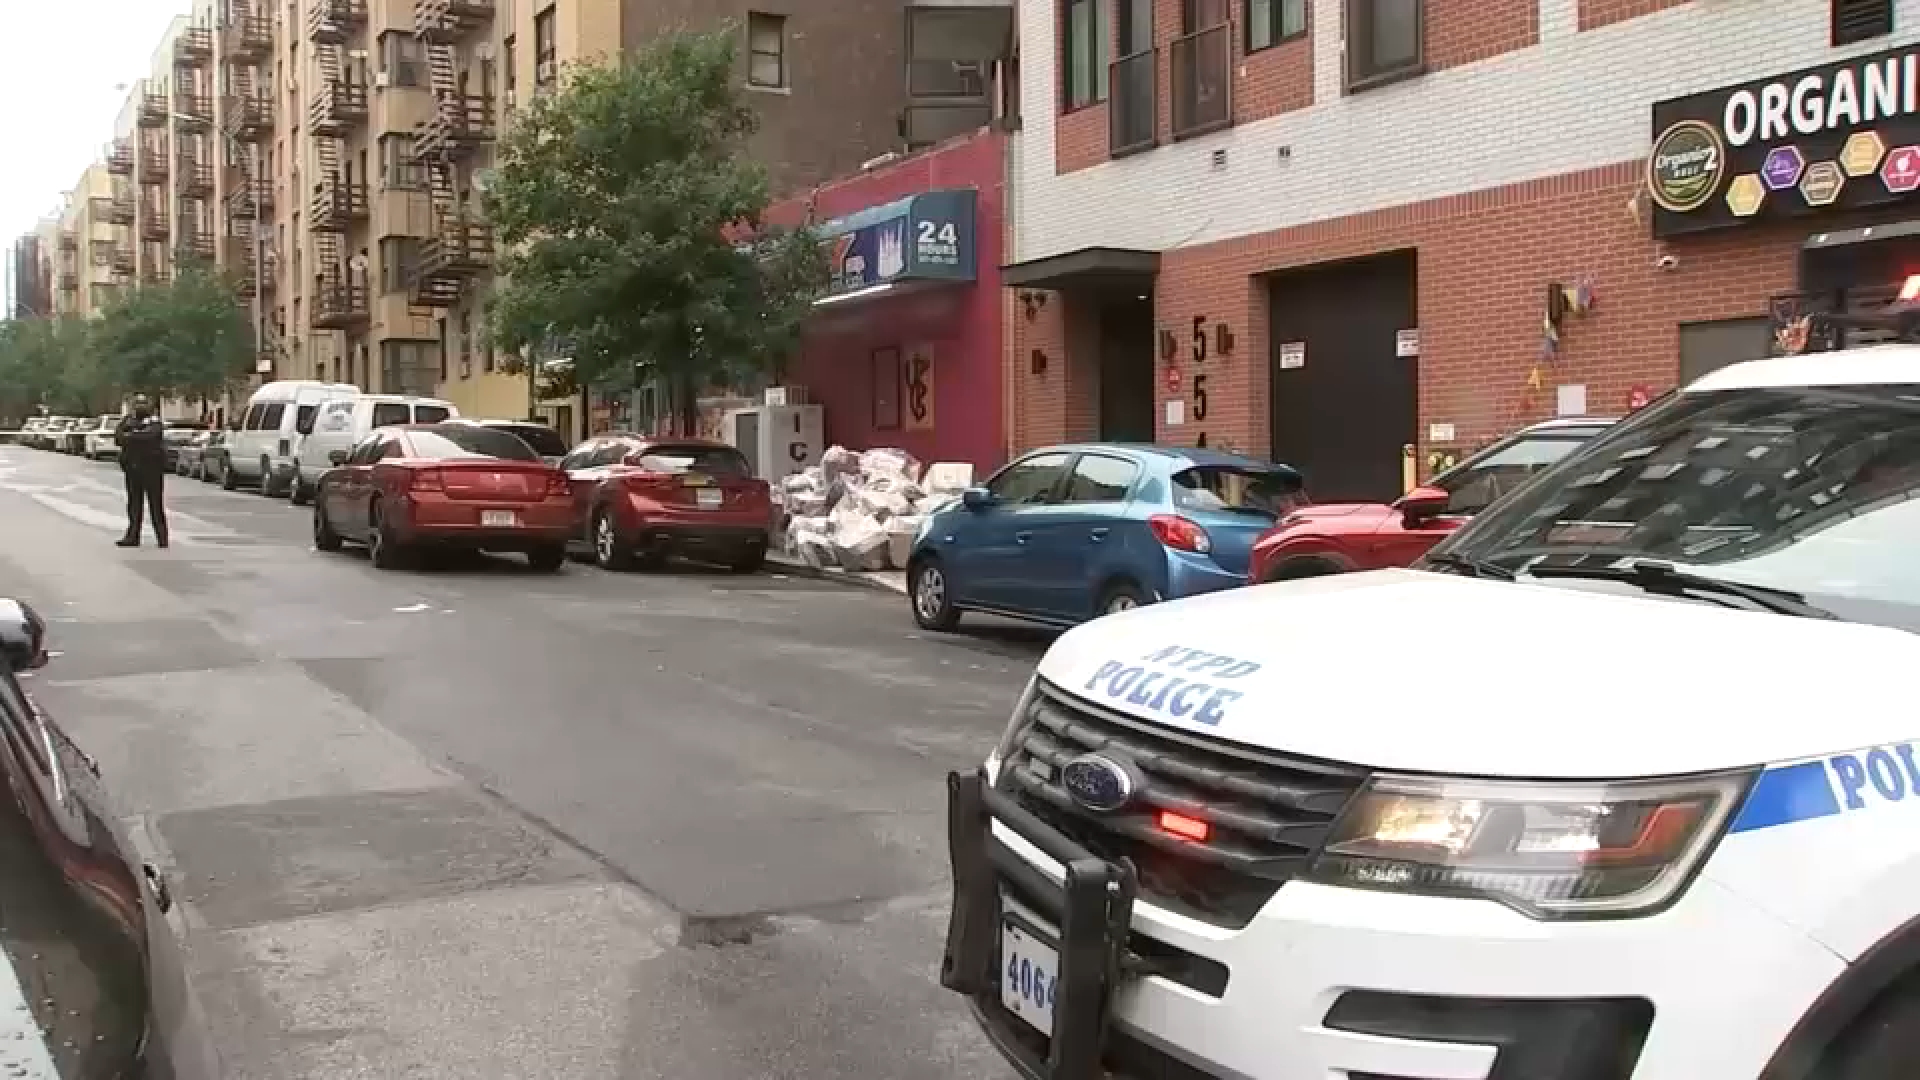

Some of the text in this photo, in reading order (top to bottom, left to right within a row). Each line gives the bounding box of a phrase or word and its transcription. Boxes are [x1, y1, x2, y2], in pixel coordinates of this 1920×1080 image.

[918, 220, 957, 244] 24
[788, 411, 808, 474] IC
[1140, 645, 1262, 679] NYPD
[1084, 660, 1244, 726] POLICE
